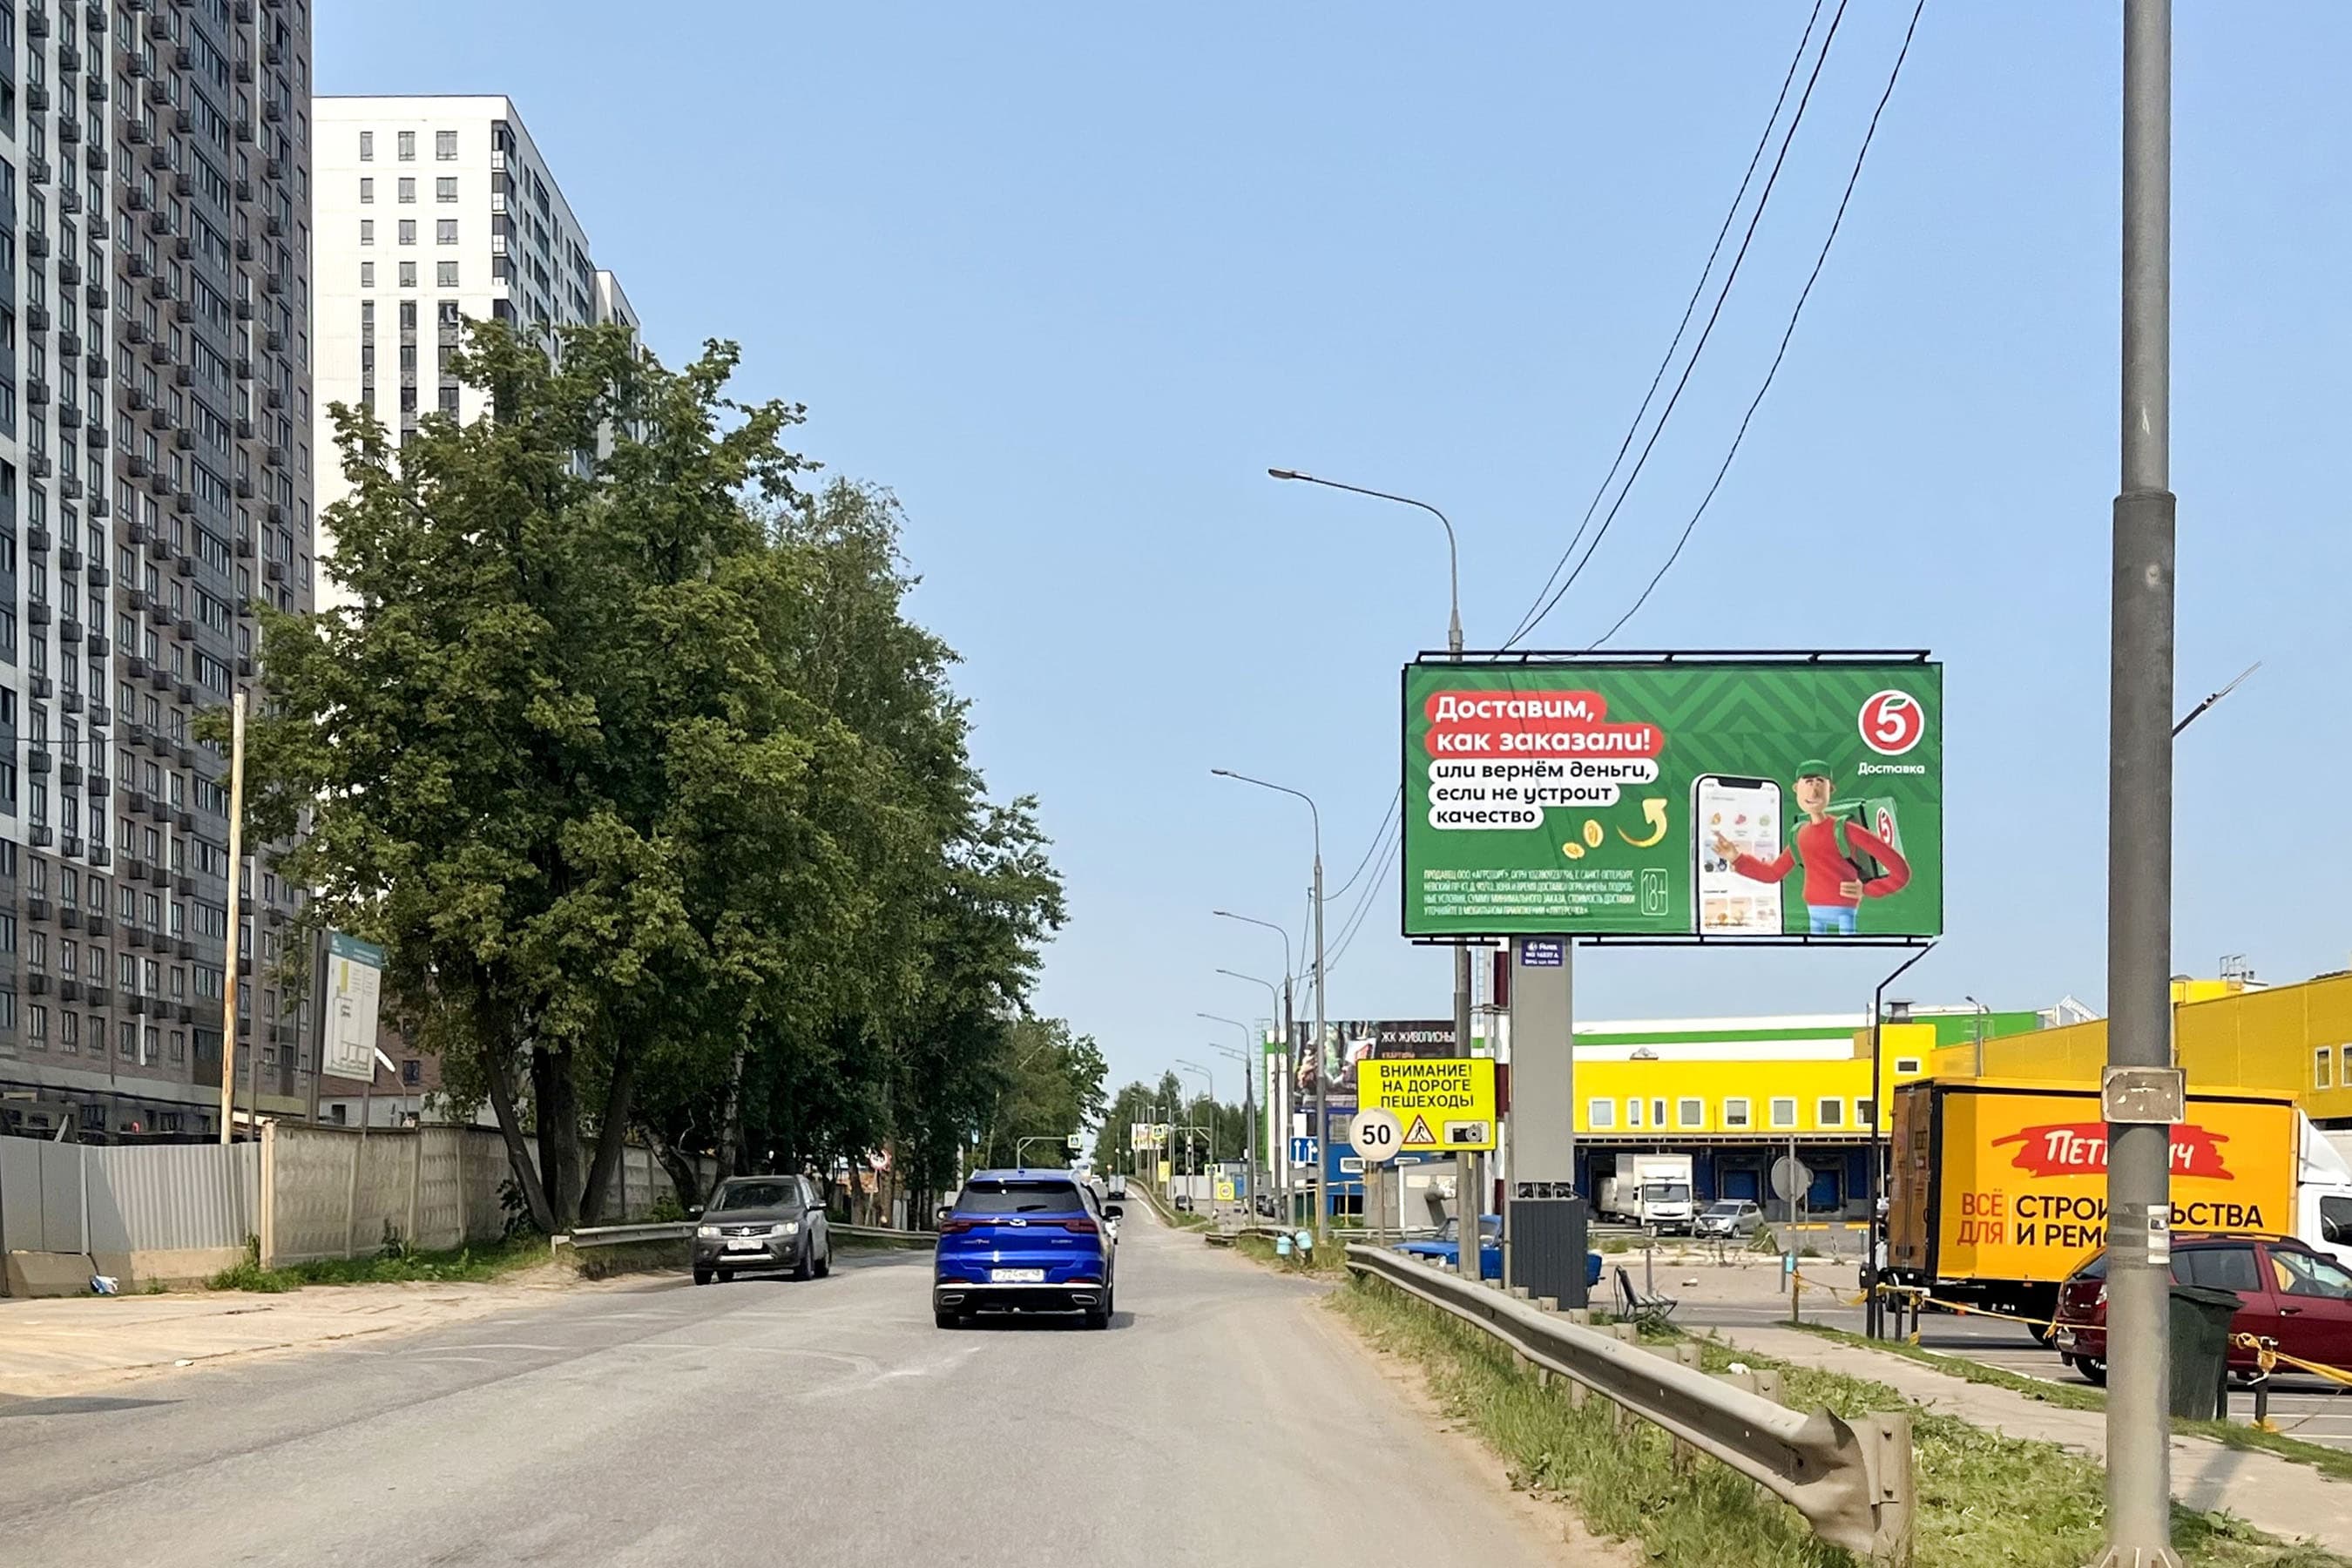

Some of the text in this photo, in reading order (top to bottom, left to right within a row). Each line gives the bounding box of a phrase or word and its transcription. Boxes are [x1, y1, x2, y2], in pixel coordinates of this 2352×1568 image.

[1435, 696, 1594, 722] Доставим,
[1436, 728, 1651, 752] как заказали!
[1436, 760, 1651, 781] или вернём деньги,
[1857, 762, 1925, 775] Доставка
[1436, 787, 1612, 804] если не устроит
[1436, 810, 1536, 823] качество
[1642, 874, 1666, 911] 18+
[1380, 1064, 1472, 1078] ВНИМАНИЕ!
[1382, 1078, 1471, 1093] НА ДОРОГЕ
[1381, 1094, 1474, 1108] ПЕШЕХОДЫ
[1362, 1125, 1390, 1145] 50
[1963, 1188, 2004, 1217] ВСЁ
[1957, 1220, 2004, 1247] ДЛЯ
[2017, 1223, 2035, 1246] И
